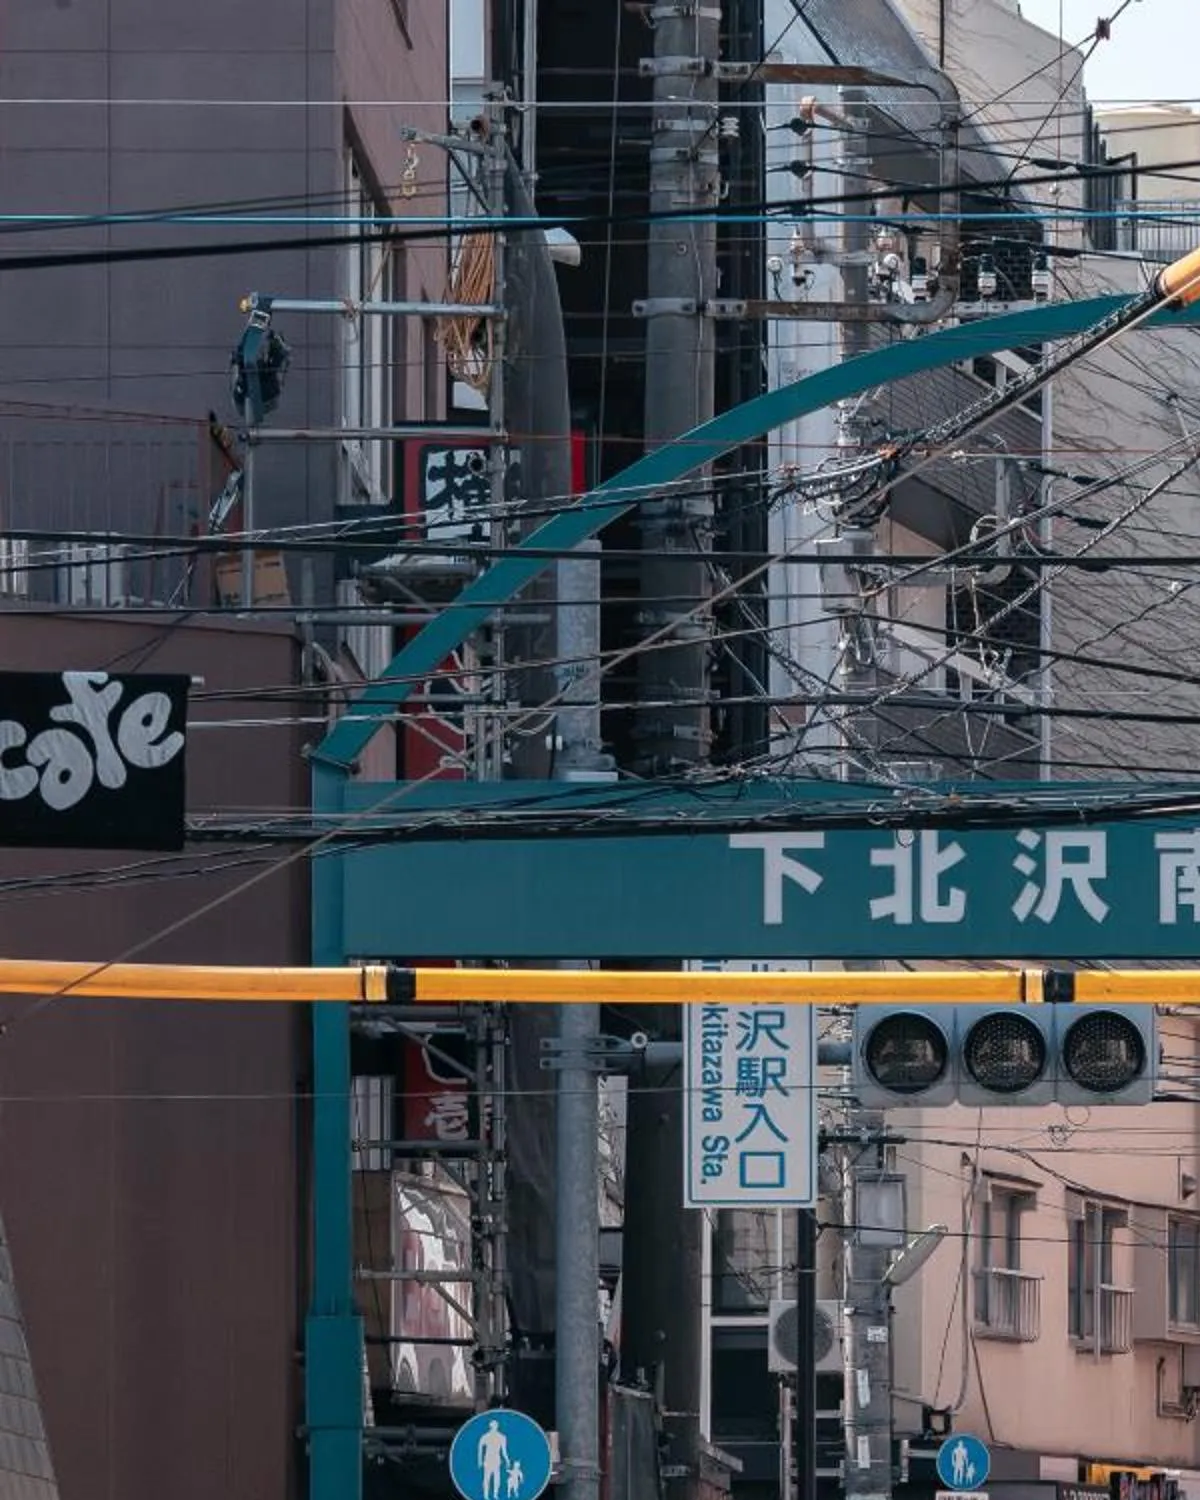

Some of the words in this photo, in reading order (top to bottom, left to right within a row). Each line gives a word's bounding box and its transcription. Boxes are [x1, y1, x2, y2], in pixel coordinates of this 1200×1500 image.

[735, 1005, 790, 1189] 沢駅入口
[701, 1135, 730, 1185] Sta.
